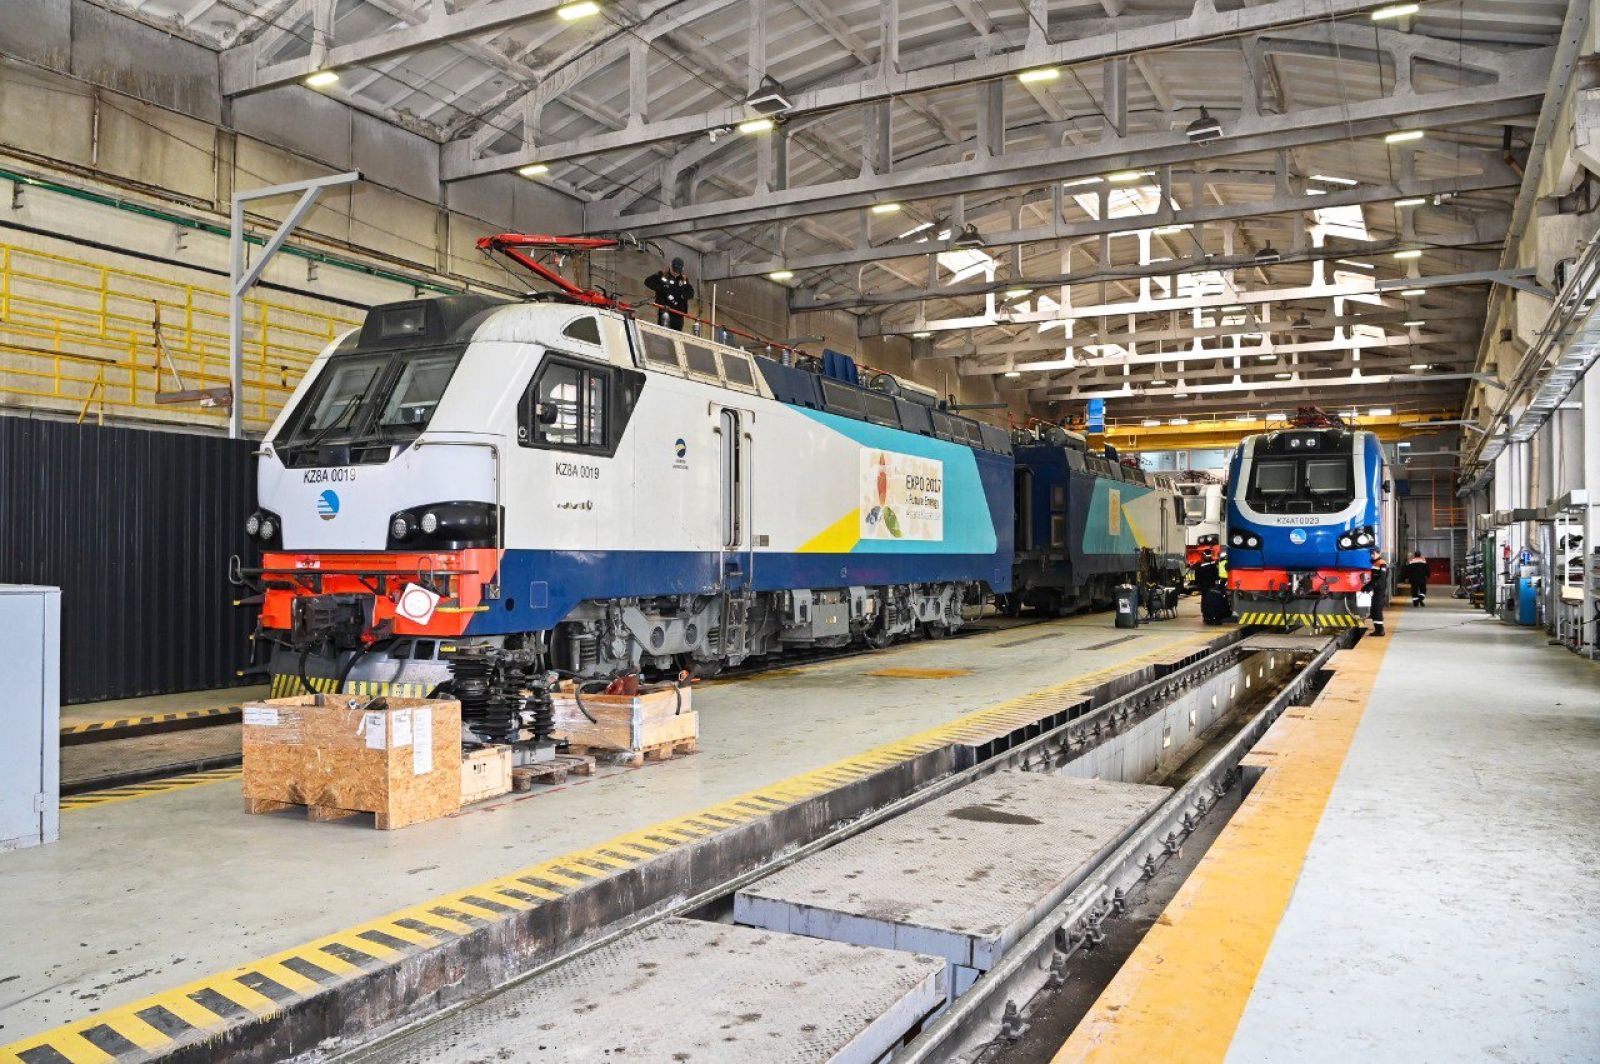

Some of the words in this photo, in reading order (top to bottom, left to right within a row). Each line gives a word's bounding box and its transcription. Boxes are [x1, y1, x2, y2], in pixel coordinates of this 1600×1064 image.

[303, 469, 328, 483] KZ8A
[331, 468, 355, 481] 0019
[555, 462, 578, 477] KZ8A
[580, 465, 600, 479] 0019
[906, 474, 925, 491] EXPO
[926, 477, 942, 493] 2017
